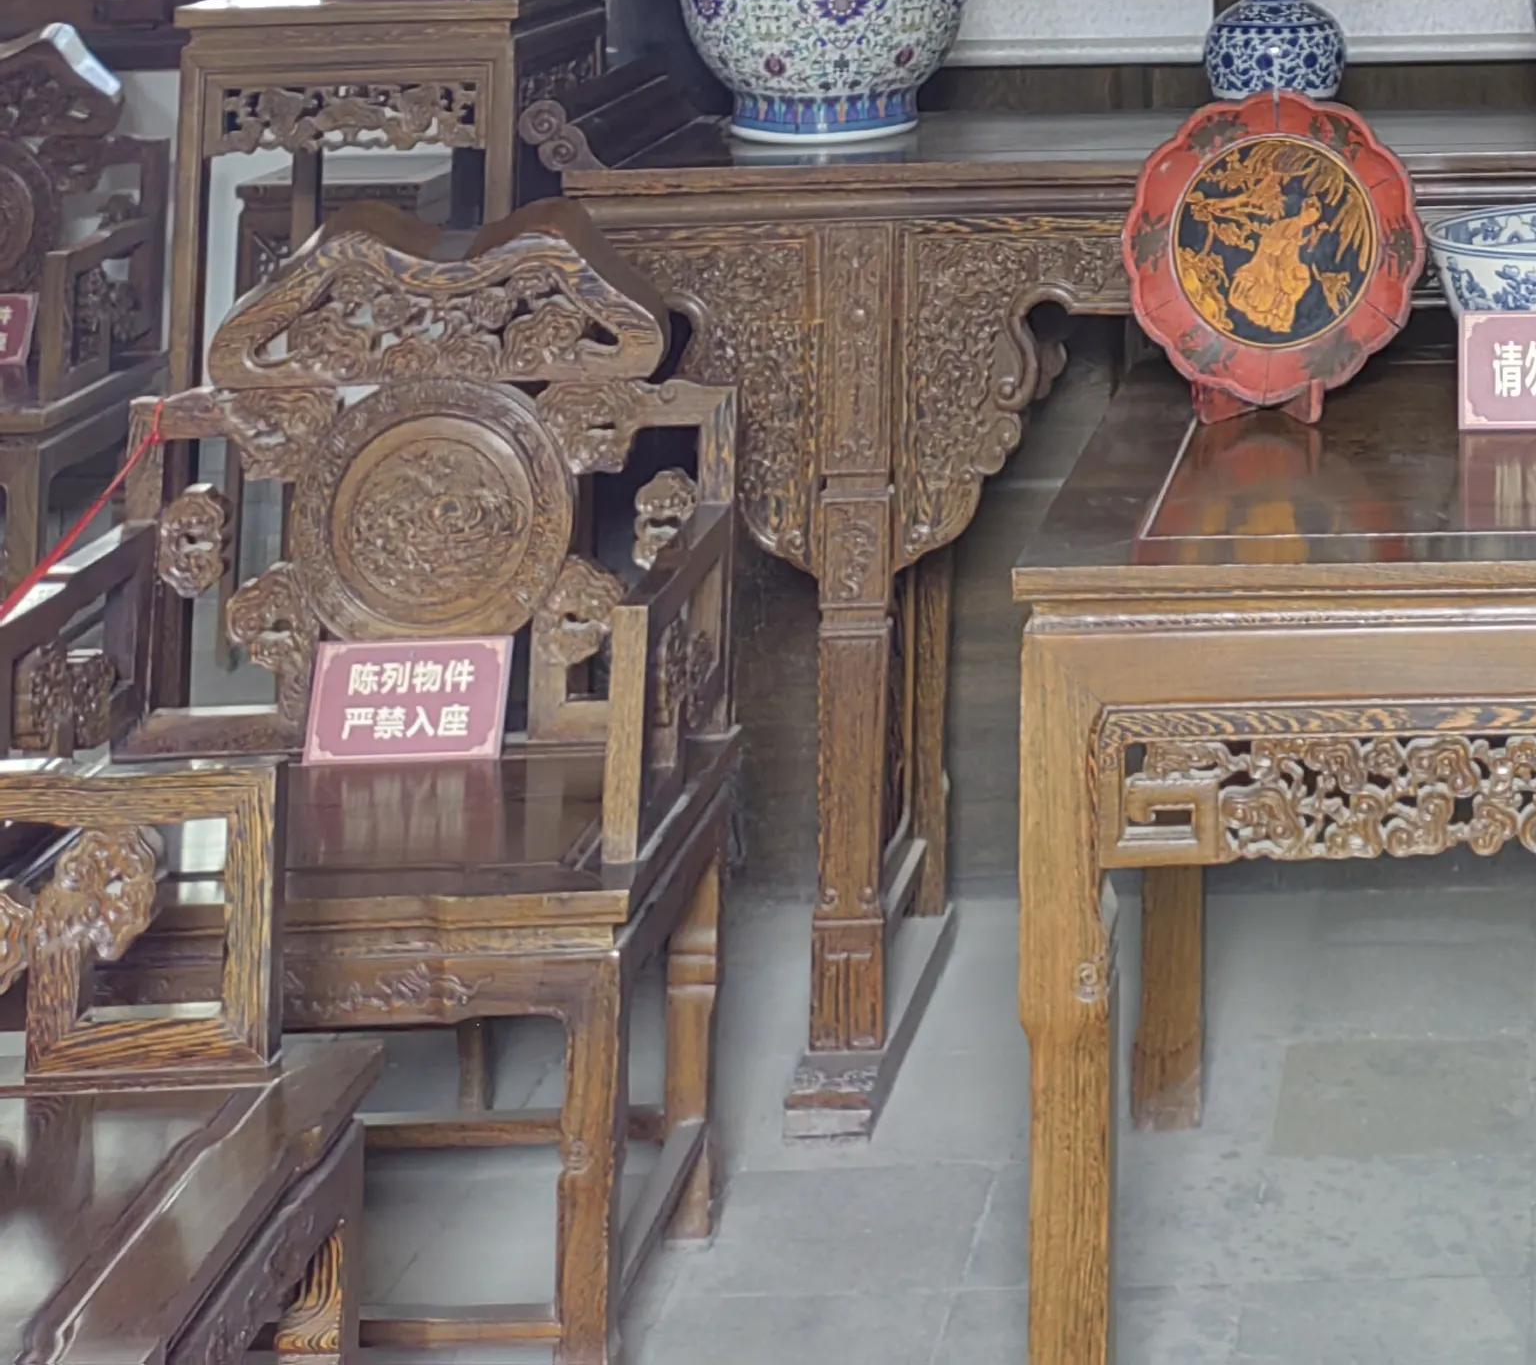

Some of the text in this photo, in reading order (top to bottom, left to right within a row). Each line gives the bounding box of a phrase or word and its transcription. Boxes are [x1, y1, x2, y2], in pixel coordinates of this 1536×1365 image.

[347, 658, 475, 696] 陈列物件
[341, 703, 471, 740] 严禁入座
